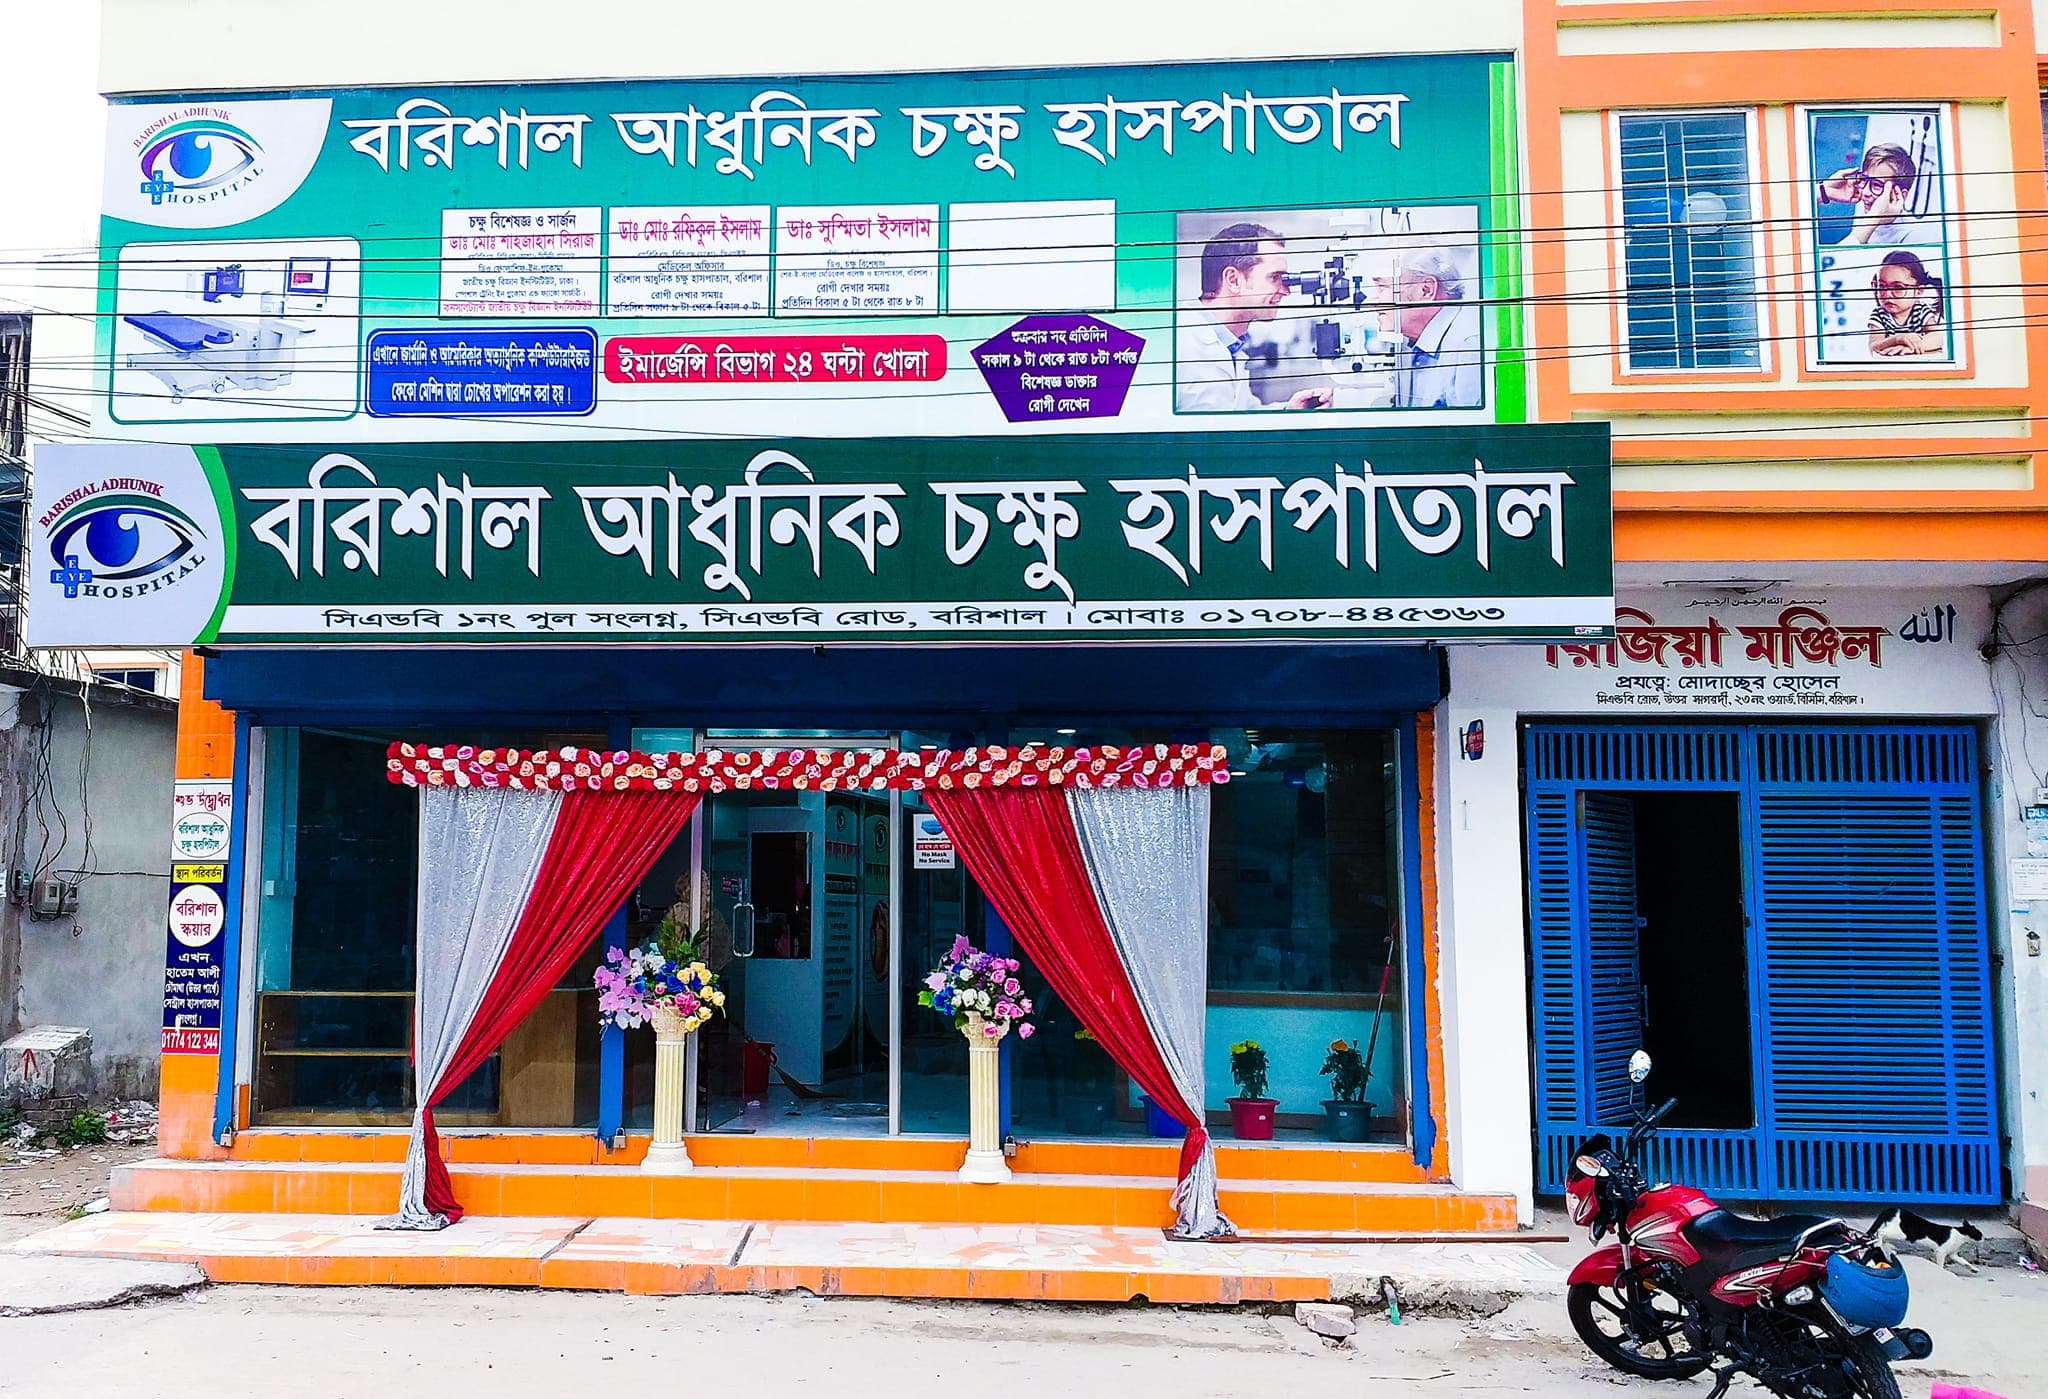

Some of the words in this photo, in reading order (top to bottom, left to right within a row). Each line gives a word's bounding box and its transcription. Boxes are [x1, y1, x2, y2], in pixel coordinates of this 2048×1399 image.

[133, 111, 181, 148] BARISHAL
[183, 107, 231, 121] ADHUNIK
[341, 97, 593, 173] বরিশাল
[609, 91, 881, 181] আধুনিক
[900, 106, 1025, 179] চক্ষু
[1045, 87, 1411, 166] হাসপাতাল
[168, 167, 263, 205] HOSPITAL
[469, 215, 487, 232] চক্ষু
[490, 212, 532, 229] বিশেষজ্ঞ
[535, 216, 544, 228] ও
[548, 210, 577, 229] সার্জন
[618, 219, 638, 242] ডাঃ
[644, 219, 668, 242] মোঃ
[672, 213, 716, 248] রফিকুল
[720, 213, 762, 242] ইসলাম
[786, 218, 812, 241] ডাঃ
[818, 213, 872, 244] সুস্মিতা
[877, 212, 931, 240] ইসলাম
[658, 260, 692, 272] মেডিকেল
[694, 260, 725, 271] অফিসার
[613, 274, 640, 285] বরিশাল
[643, 273, 672, 285] আধুনিক
[675, 274, 688, 286] চক্ষু
[735, 272, 762, 283] বরিশাল
[816, 281, 837, 293] রোগী
[840, 283, 864, 293] দেখার
[867, 283, 890, 292] সময়ঃ
[782, 296, 812, 309] প্রতিদিন
[815, 296, 840, 308] বিকাল
[842, 298, 849, 307] ৫
[851, 296, 860, 307] টা
[863, 297, 884, 306] থেকে
[887, 297, 903, 306] রাত
[905, 297, 912, 306] ৮
[915, 295, 924, 306] টা
[1051, 329, 1067, 345] সহ
[1069, 325, 1107, 344] প্রতিদিন
[618, 344, 708, 381] ইমার্জেন্সি
[714, 344, 775, 378] বিভাগ
[784, 350, 812, 381] ২৪
[873, 347, 929, 378] খোলা
[981, 352, 1010, 368] সকাল
[1013, 355, 1022, 367] ৯
[1024, 350, 1036, 367] টা
[1039, 353, 1065, 367] থেকে
[1068, 352, 1087, 366] রাত
[1113, 347, 1138, 364] পর্যন্ত
[1021, 373, 1062, 390] বিশেষজ্ঞ
[1064, 374, 1097, 389] ডাক্তার
[1028, 395, 1055, 413] রোগী
[1058, 398, 1090, 412] দেখেন
[38, 481, 100, 528] BARISHAL
[101, 478, 164, 497] ADHUNIK
[240, 452, 552, 580] বরিশাল
[573, 449, 907, 600] আধুনিক
[928, 480, 1087, 607] চক্ষু
[1108, 458, 1576, 588] হাসপাতাল
[83, 554, 206, 598] HOSPITAL
[457, 612, 515, 629] ১নং
[527, 611, 577, 631] পুল
[585, 610, 688, 630] সংলগ্ন,
[836, 608, 917, 629] রোড,
[929, 605, 1046, 625] বরিশাল
[1087, 606, 1184, 625] মোবাঃ
[1200, 605, 1505, 624] ০১৭০৮-৪৪৫৩৬৩
[1736, 606, 1894, 669] মঞ্জিল
[1679, 676, 1766, 692] মোদাচ্ছের
[1773, 676, 1840, 692] হোসেন
[176, 794, 194, 806] শুভ
[196, 787, 231, 811] উদ্বোধন
[179, 822, 199, 834] বরিশাল
[201, 822, 224, 835] আধুনিক
[176, 868, 190, 880] স্থান
[192, 866, 222, 878] পরিবর্তন
[176, 898, 217, 917] বরিশাল
[180, 922, 211, 937] স্কয়ার
[178, 952, 210, 963] এখন
[165, 967, 194, 979] হাতেম
[197, 965, 220, 979] আলী
[161, 1032, 184, 1048] 01774
[187, 1033, 201, 1049] 122
[203, 1033, 218, 1049] 344
